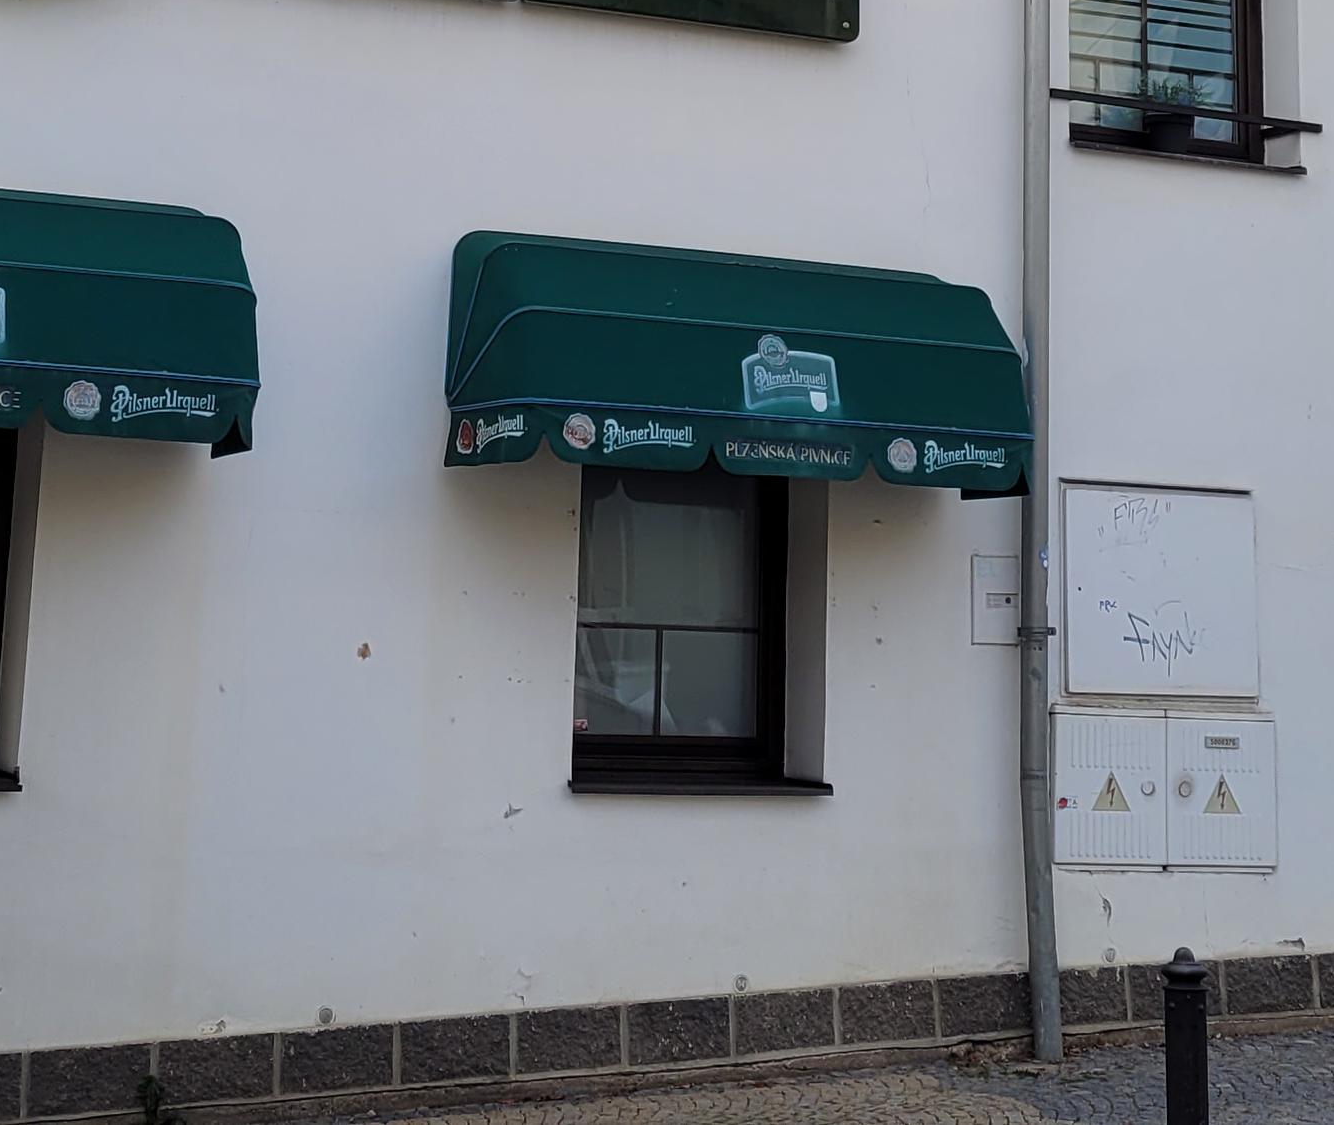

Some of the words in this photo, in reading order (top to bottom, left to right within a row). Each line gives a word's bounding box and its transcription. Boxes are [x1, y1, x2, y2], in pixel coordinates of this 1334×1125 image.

[789, 367, 827, 390] Urquell
[110, 384, 166, 423] Pilsner
[165, 387, 216, 417] Urquell
[603, 418, 649, 454] Pilsner
[648, 420, 693, 448] Urquell
[923, 439, 965, 474] Pilsner
[963, 440, 1006, 469] Urquell
